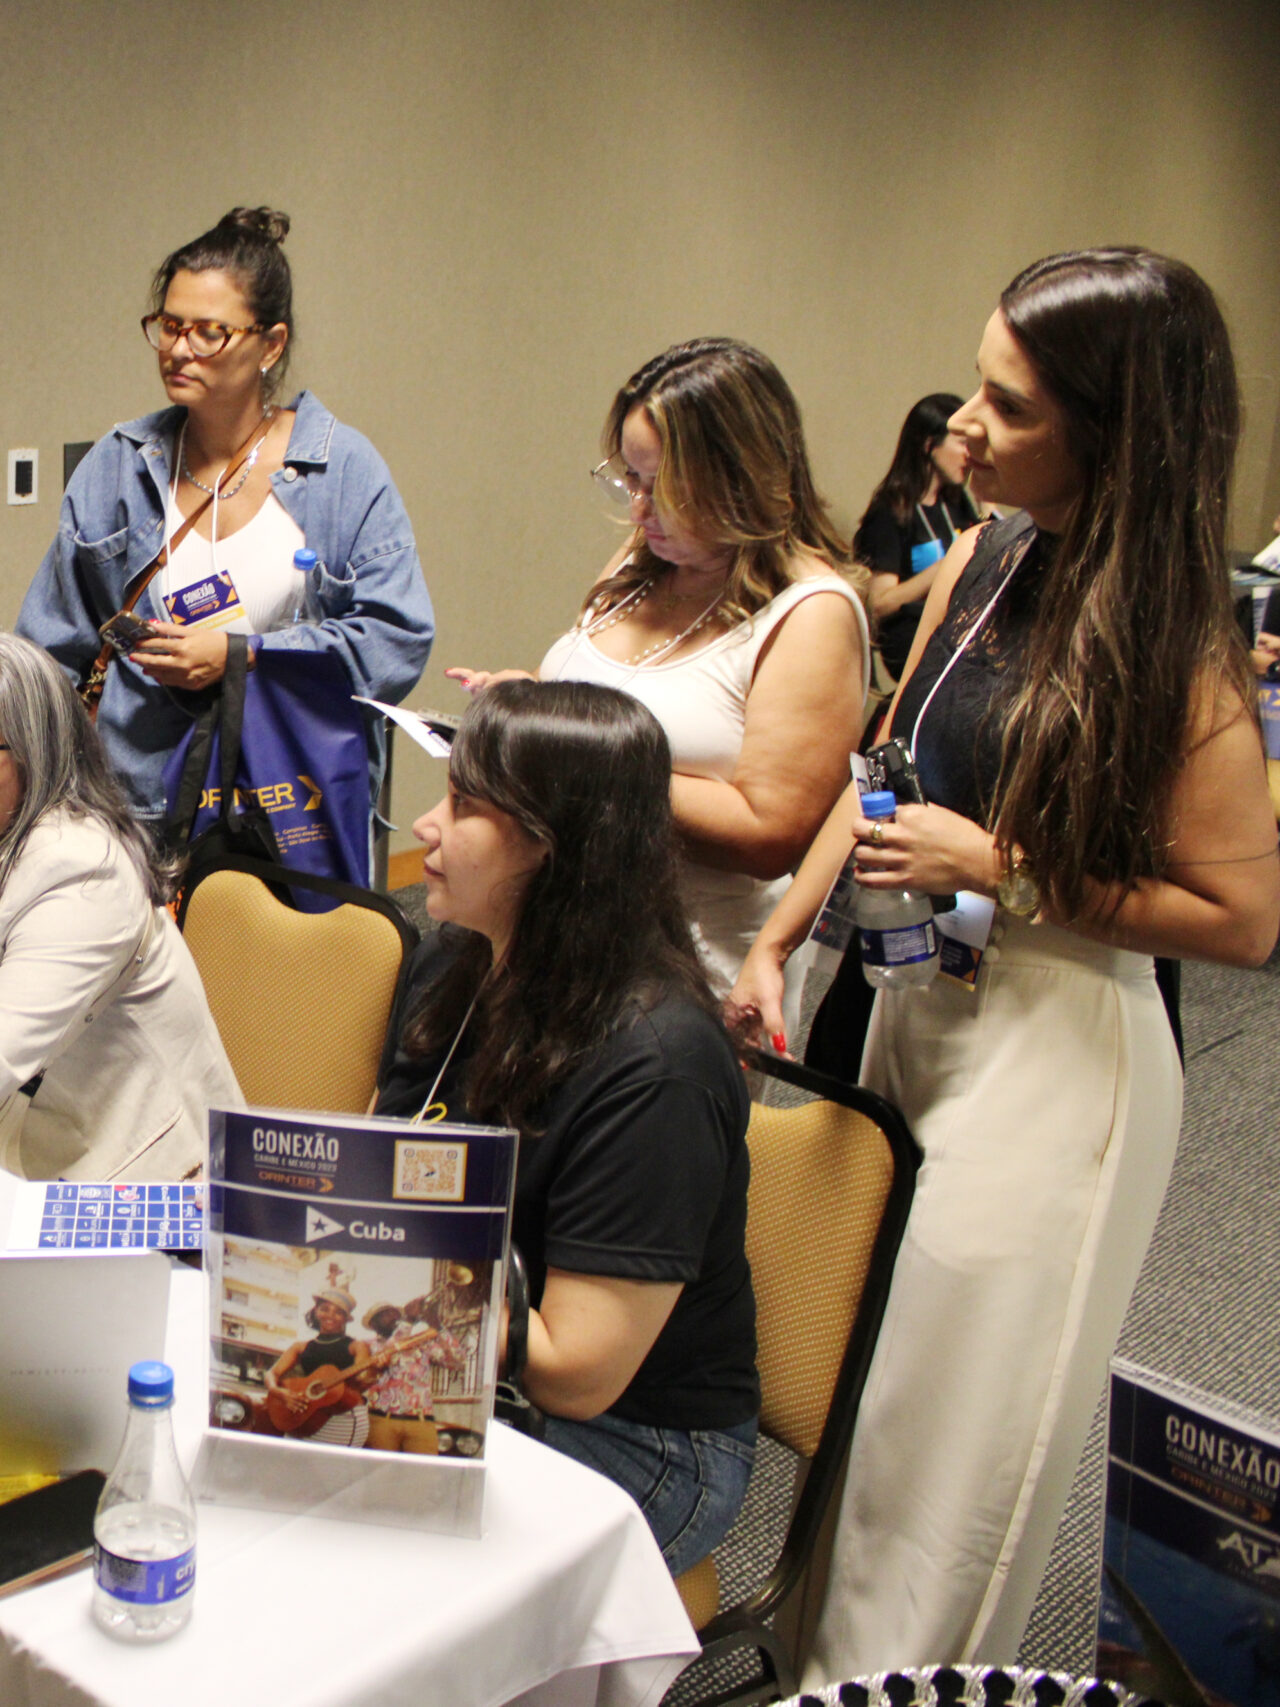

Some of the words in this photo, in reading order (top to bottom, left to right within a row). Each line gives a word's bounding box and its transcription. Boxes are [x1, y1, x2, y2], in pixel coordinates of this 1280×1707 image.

[253, 1128, 339, 1162] CONEXÃO
[349, 1221, 406, 1242] Cuba
[1165, 1414, 1280, 1489] CONEXÃO
